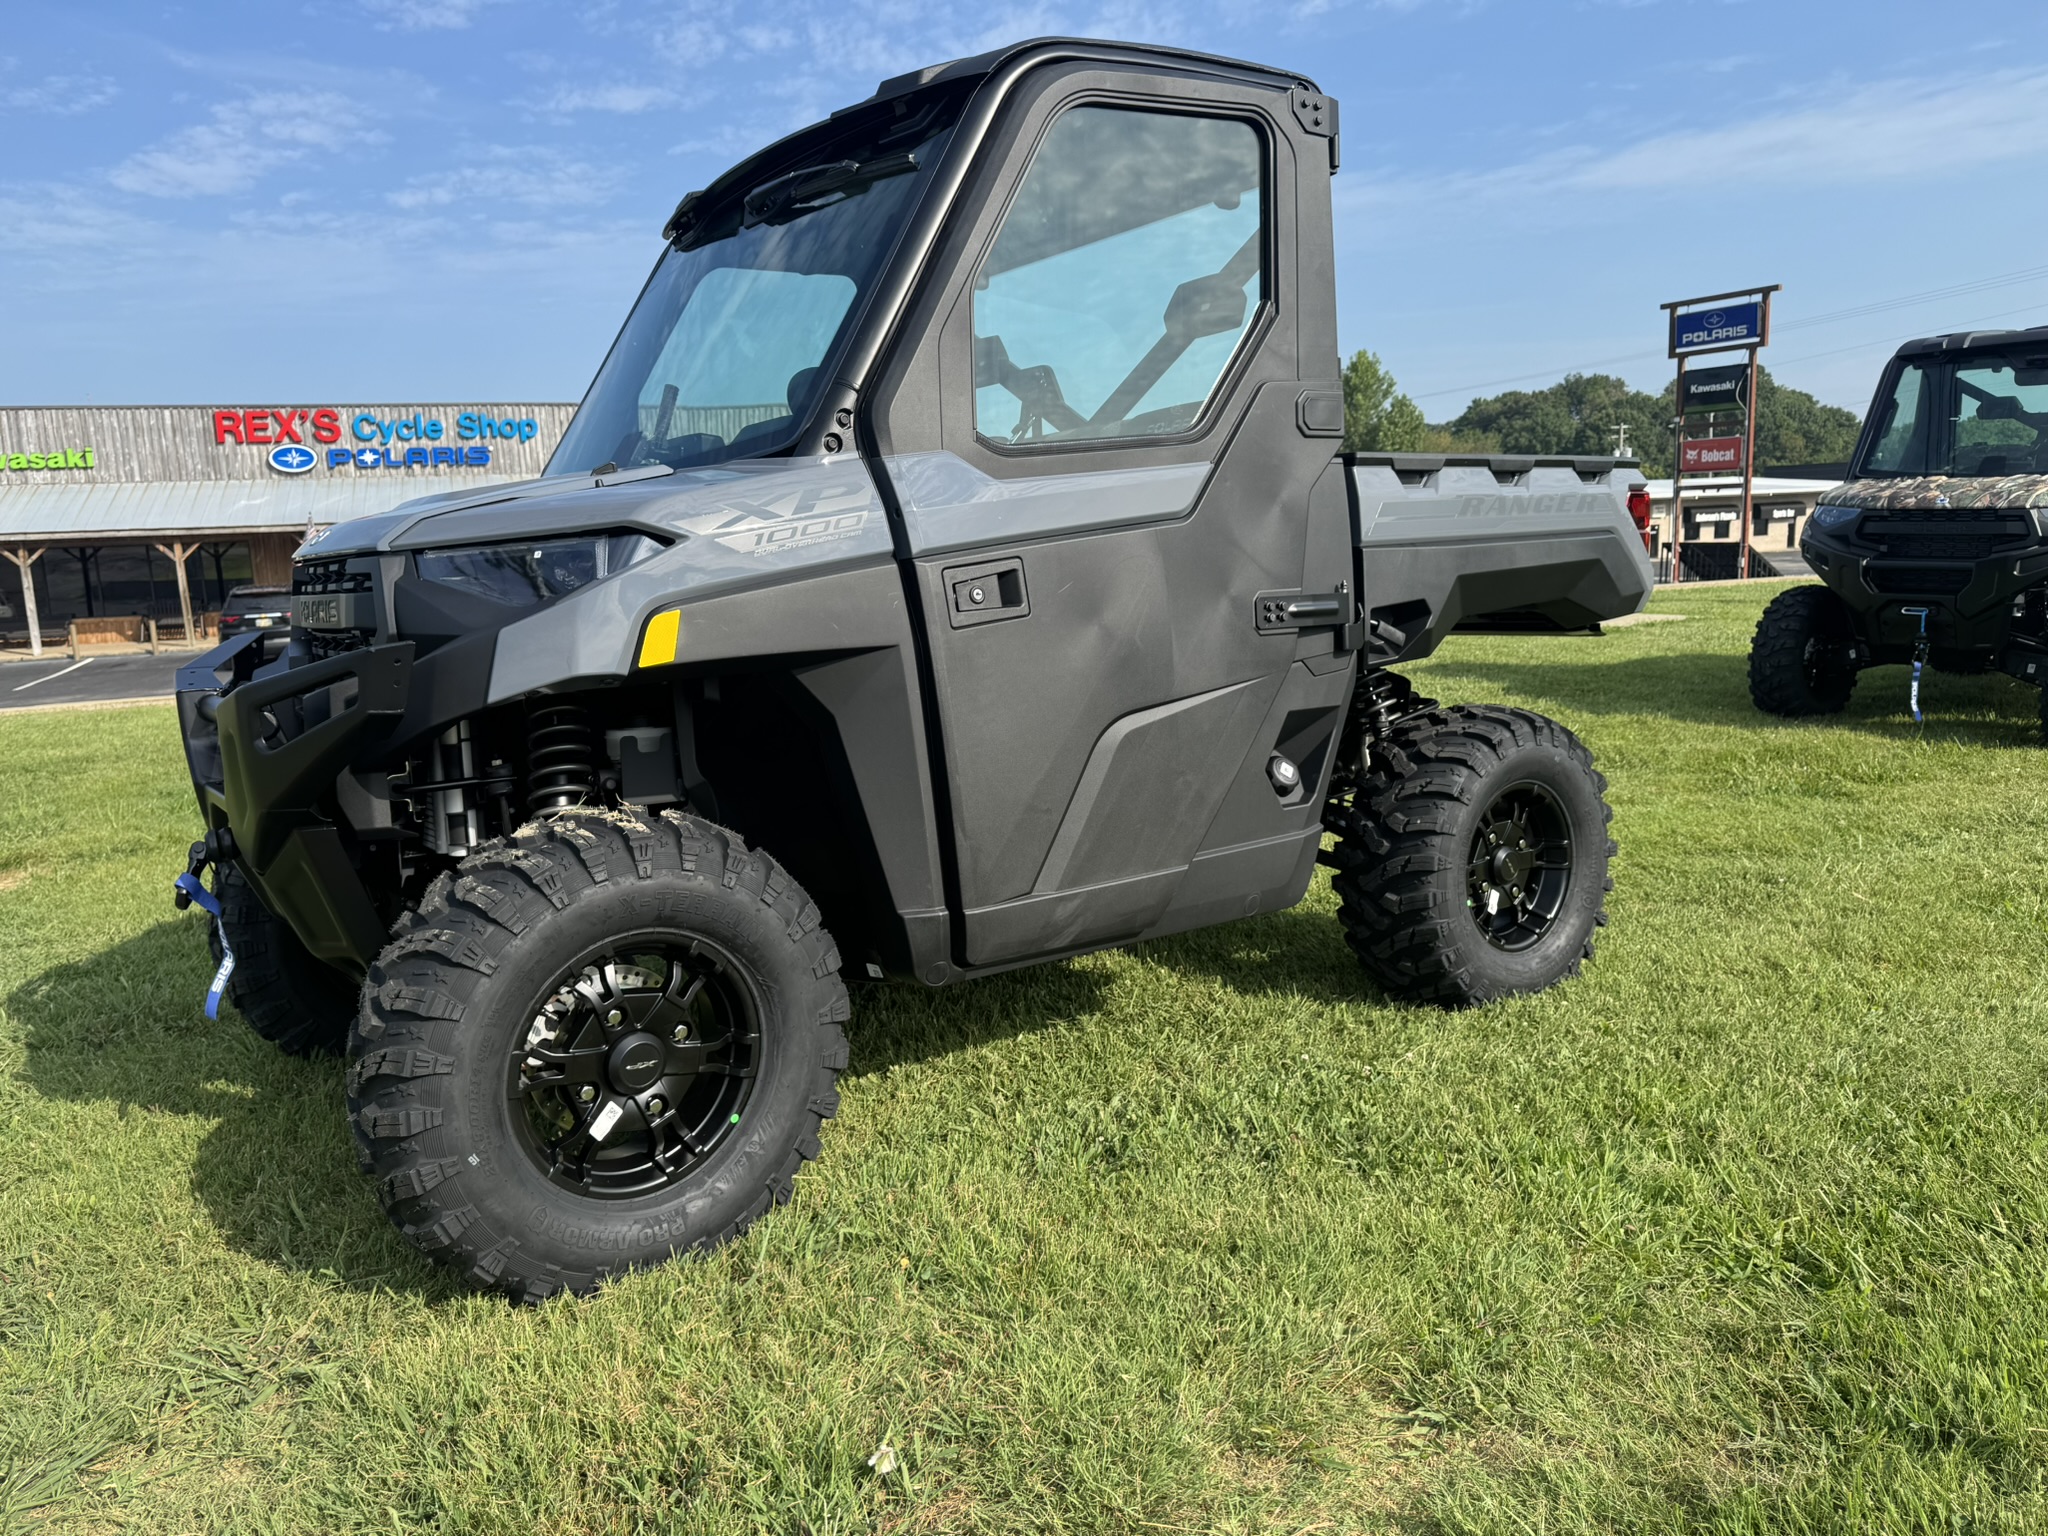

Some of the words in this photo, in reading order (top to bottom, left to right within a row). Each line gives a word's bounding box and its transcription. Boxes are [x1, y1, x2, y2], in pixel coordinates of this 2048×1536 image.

[1682, 325, 1748, 344] POLARIS
[1690, 381, 1736, 394] Kawasaki
[213, 409, 342, 444] REX'S
[353, 413, 443, 445] Cycle
[457, 412, 538, 442] Shop
[0, 447, 94, 470] asaki
[327, 446, 491, 468] POLARIS
[1701, 448, 1735, 463] Bobcat
[713, 483, 867, 530] XP
[1457, 493, 1597, 517] RANGER
[754, 515, 863, 547] 1000
[552, 1222, 632, 1250] ARMOR
[638, 1214, 687, 1247] PRO
